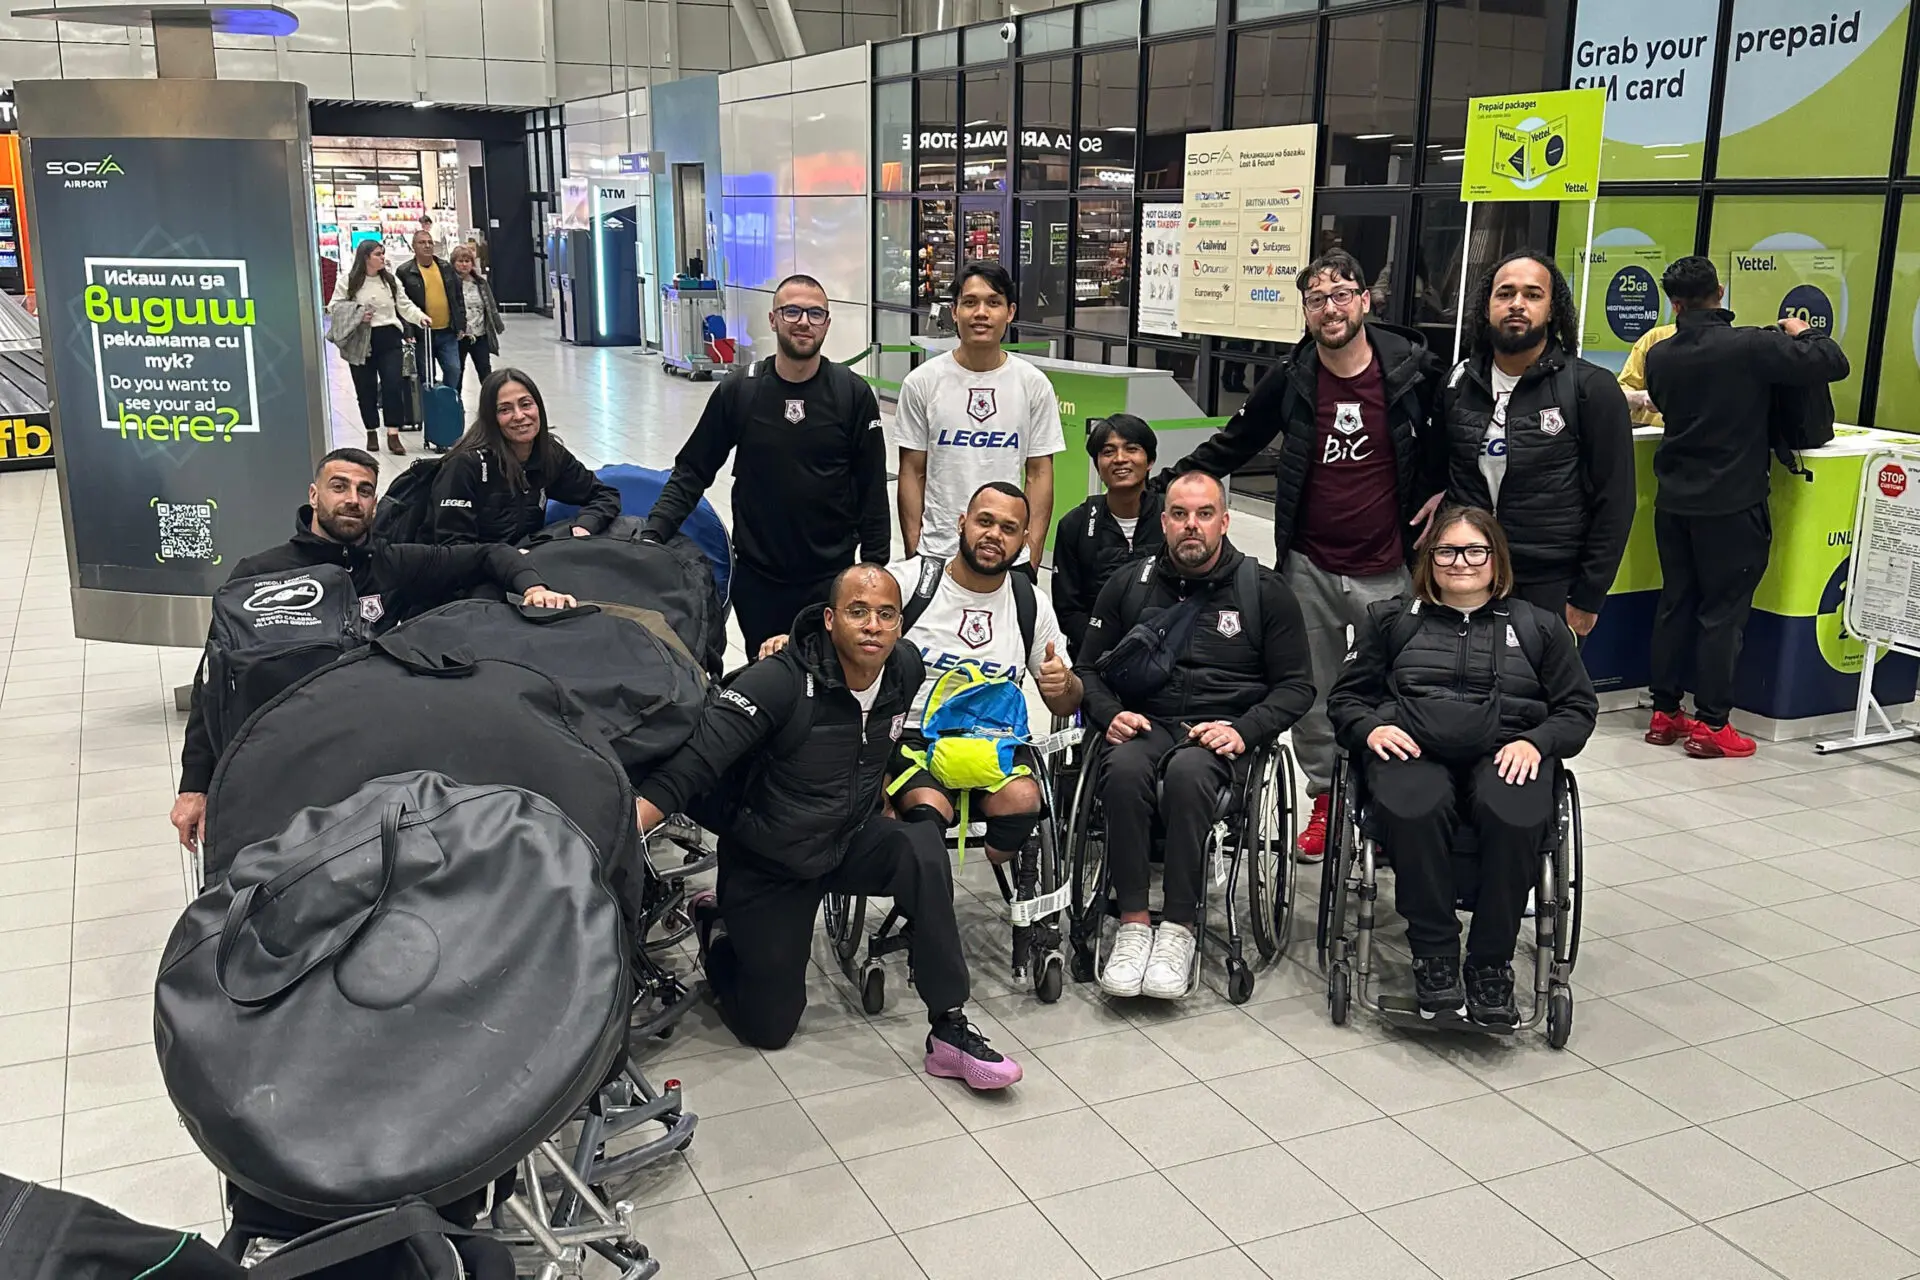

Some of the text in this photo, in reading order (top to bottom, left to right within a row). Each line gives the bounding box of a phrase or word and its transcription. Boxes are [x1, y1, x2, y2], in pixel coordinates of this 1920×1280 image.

[1577, 10, 1861, 68] Grab your prepaid
[1626, 69, 1685, 100] card
[1478, 100, 1537, 112] Prepaid packages
[64, 180, 108, 189] AIRPORT
[600, 188, 625, 199] ATM
[1146, 210, 1182, 219] NOT CLEARED
[1145, 220, 1180, 229] FOR TAKEOFF
[1579, 251, 1607, 264] Yttel.
[1737, 255, 1777, 271] Yettel.
[1274, 265, 1298, 275] ISRAIR
[104, 269, 225, 290] Искаш ли да
[1619, 275, 1648, 292] 25GB
[1250, 287, 1280, 302] enter
[84, 284, 256, 335] видиш
[103, 330, 240, 349] рекламата си
[145, 353, 195, 372] тук?
[110, 374, 231, 393] Do you want to
[125, 397, 216, 413] see your ad
[118, 402, 240, 443] here?
[937, 429, 1019, 449] LEGEA
[1479, 438, 1507, 457] EG
[1880, 471, 1905, 484] STOP
[1880, 483, 1904, 491] CUSTOMS
[440, 499, 472, 508] LEGEA
[1828, 530, 1852, 546] UNL
